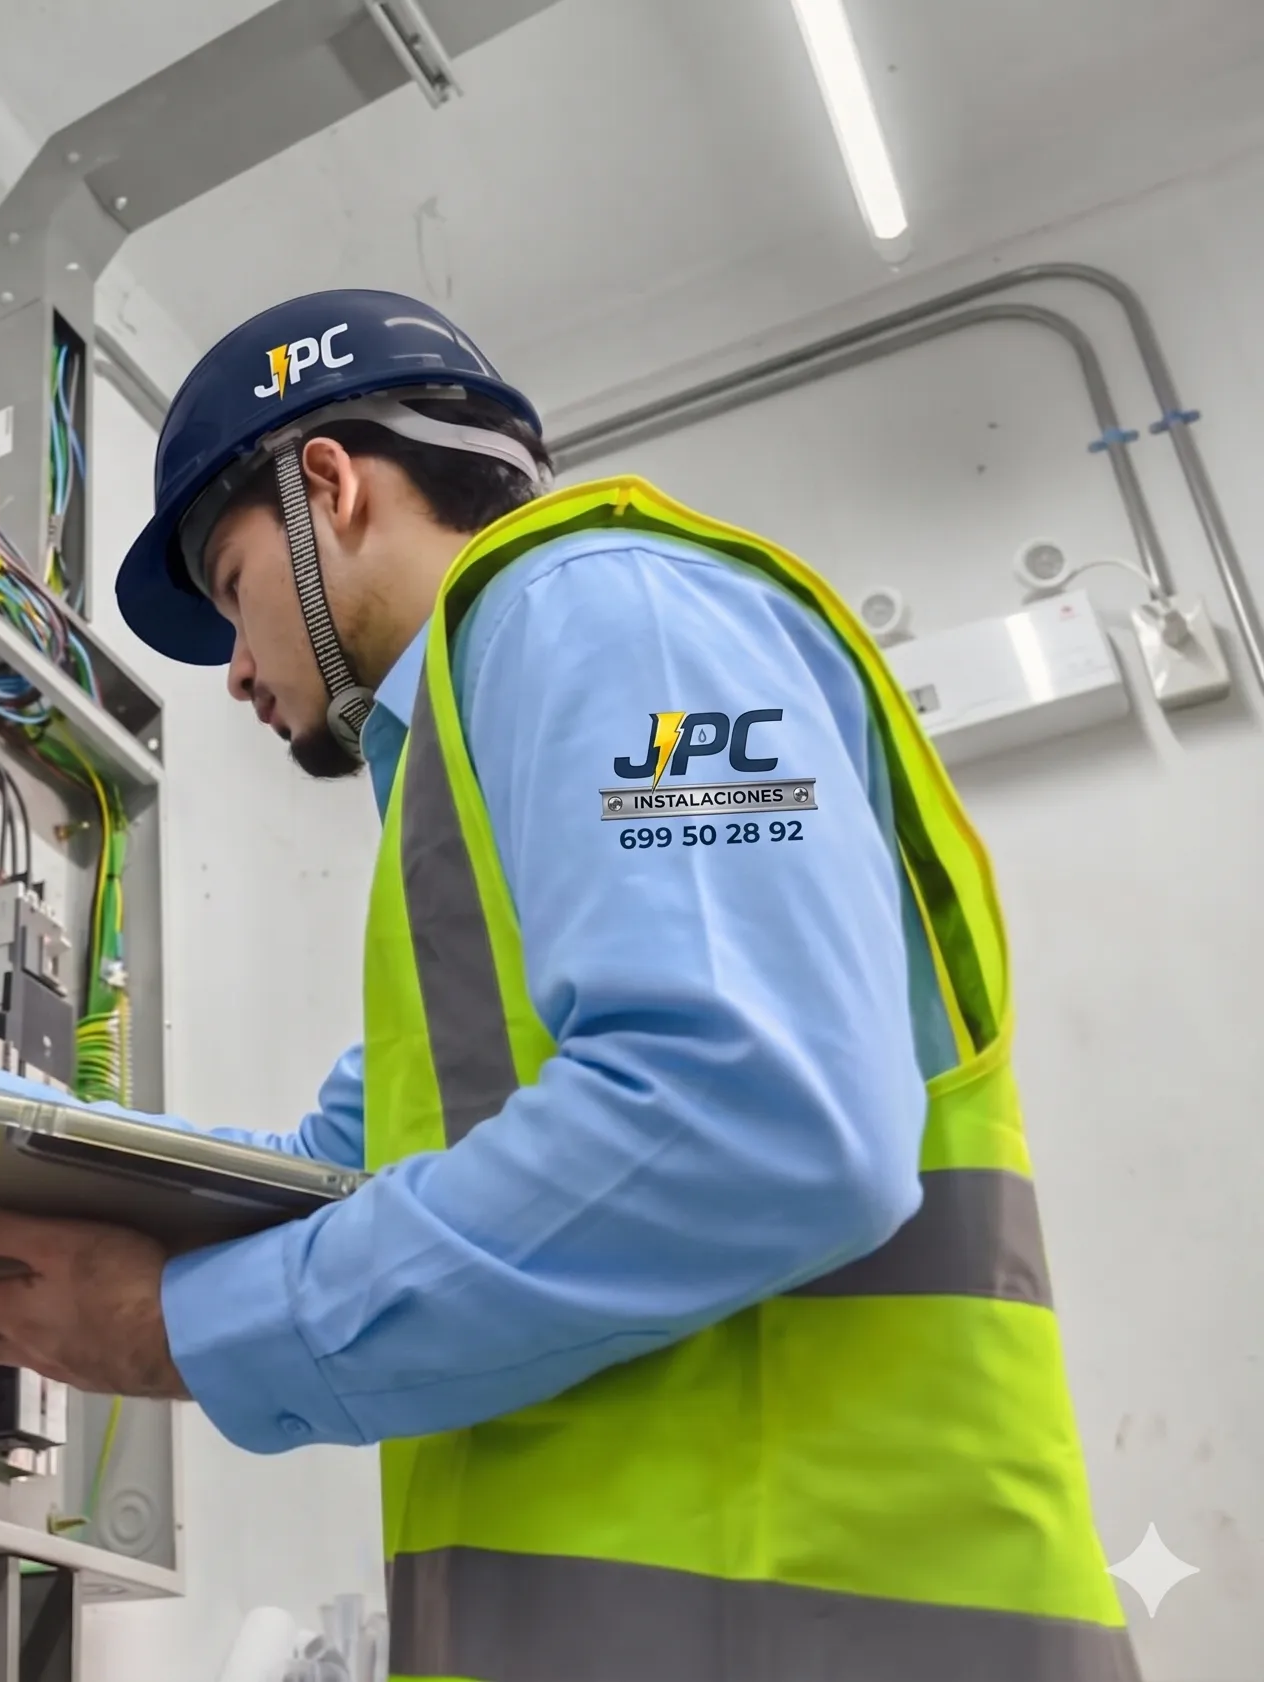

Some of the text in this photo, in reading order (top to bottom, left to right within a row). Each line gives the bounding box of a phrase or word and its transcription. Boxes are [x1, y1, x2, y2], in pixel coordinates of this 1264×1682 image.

[253, 322, 354, 400] JPC
[613, 708, 784, 780] JPC
[634, 788, 784, 810] INSTALACIONES
[619, 820, 804, 850] 699 50 28 92
